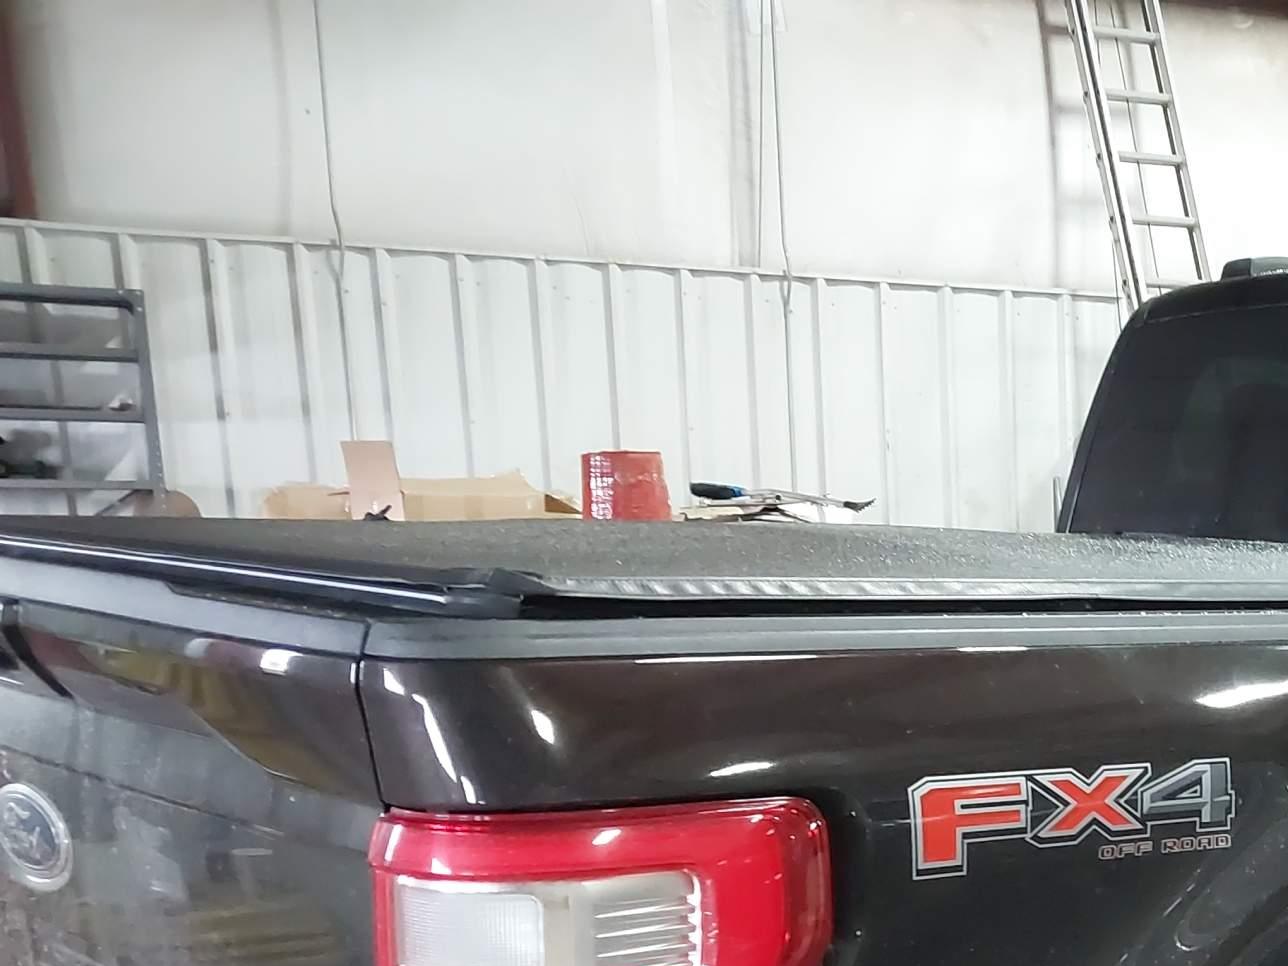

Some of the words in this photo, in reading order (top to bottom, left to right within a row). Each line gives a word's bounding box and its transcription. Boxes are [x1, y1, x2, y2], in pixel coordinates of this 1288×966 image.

[908, 757, 1235, 880] FX4
[1098, 840, 1153, 860] OFF
[1161, 833, 1232, 853] ROAD
